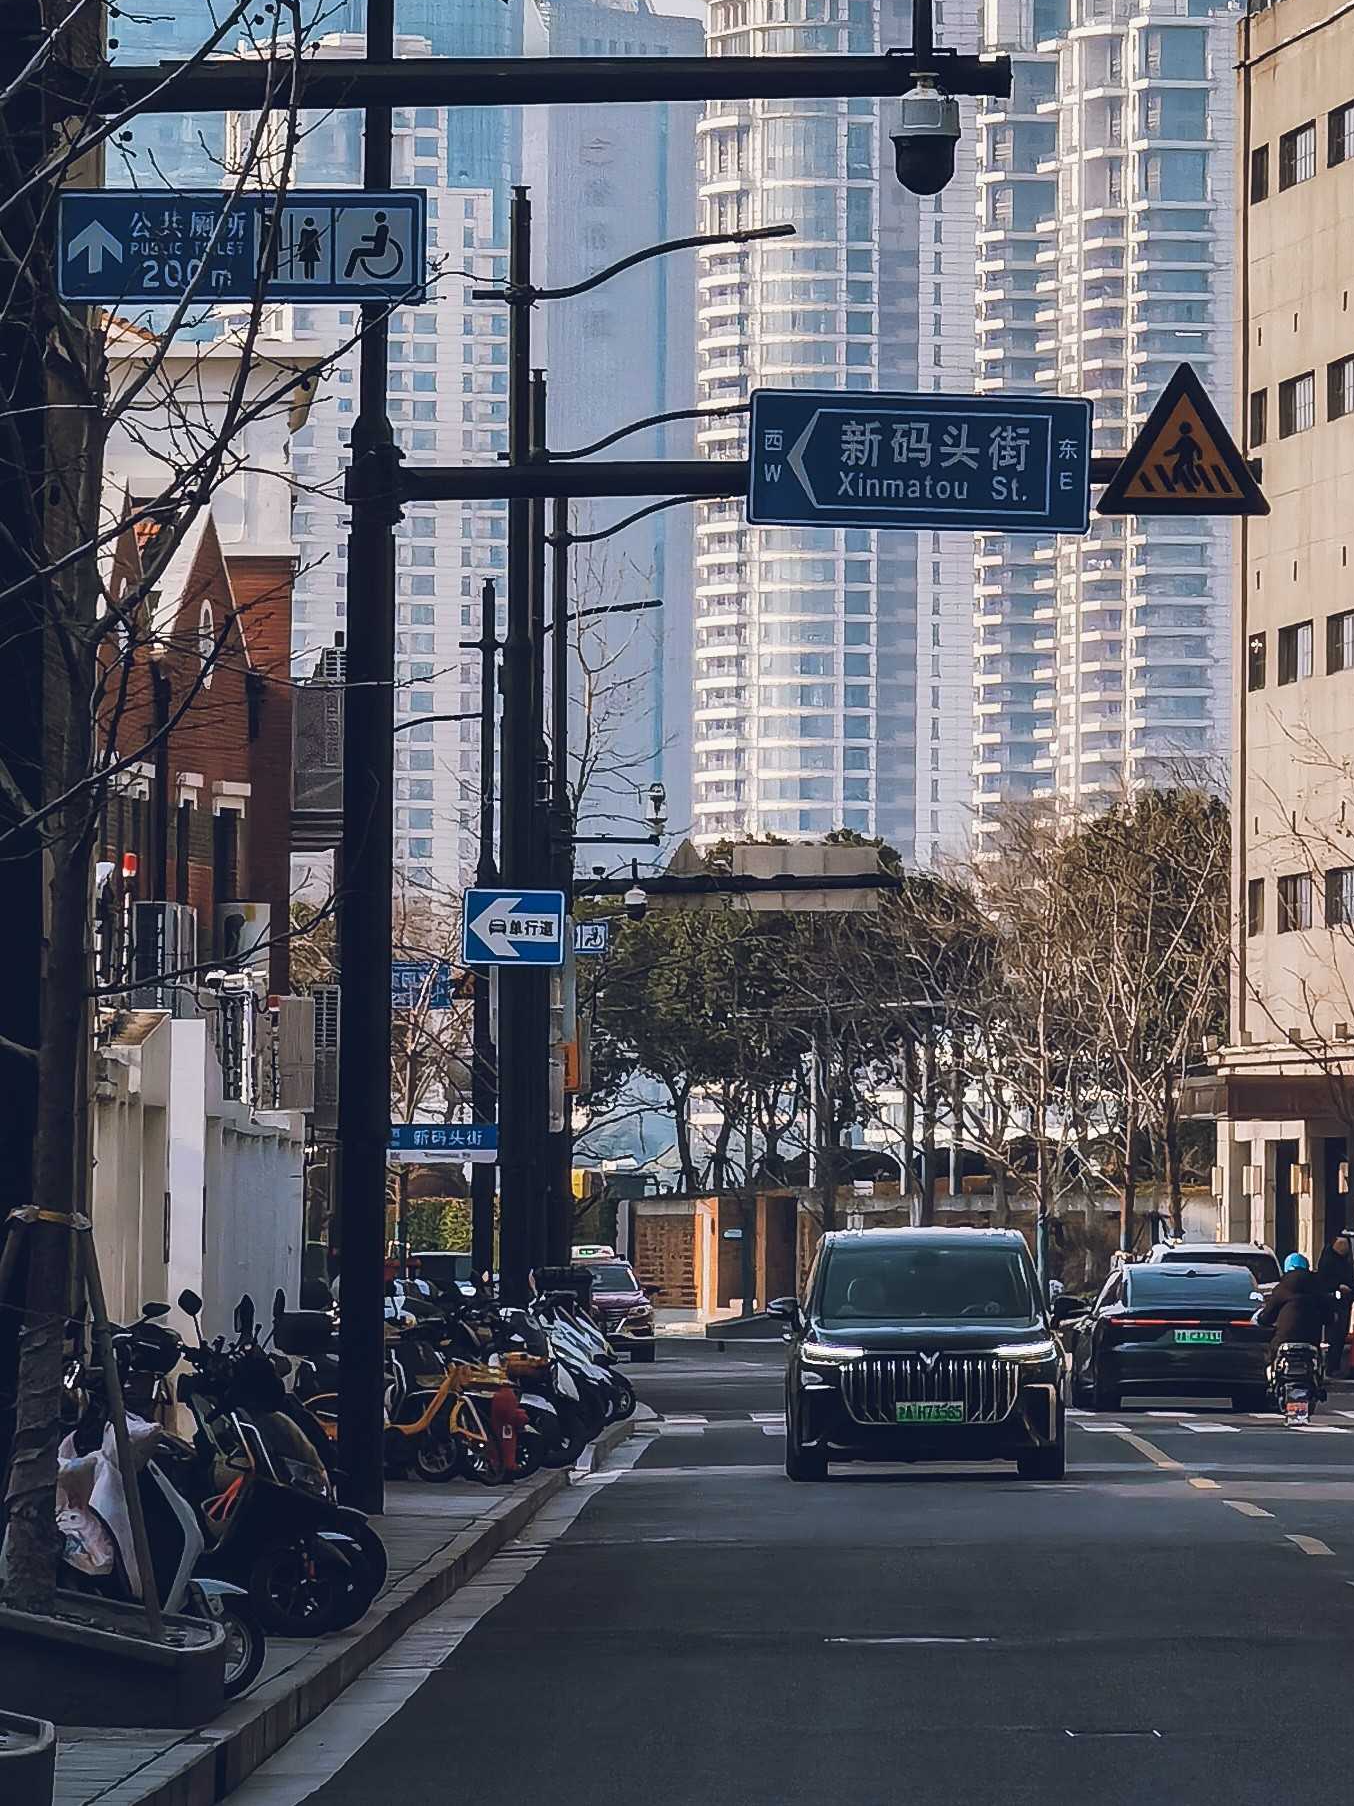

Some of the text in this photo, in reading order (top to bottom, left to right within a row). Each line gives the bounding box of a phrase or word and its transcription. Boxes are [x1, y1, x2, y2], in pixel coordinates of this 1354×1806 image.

[195, 242, 244, 256] TLET
[764, 429, 783, 451] 西
[841, 421, 1030, 472] 新码头街
[1058, 439, 1079, 460] 东
[764, 463, 782, 482] W
[1059, 472, 1073, 491] E
[838, 471, 1028, 501] Xinmatou St.
[509, 920, 554, 937] 单行道
